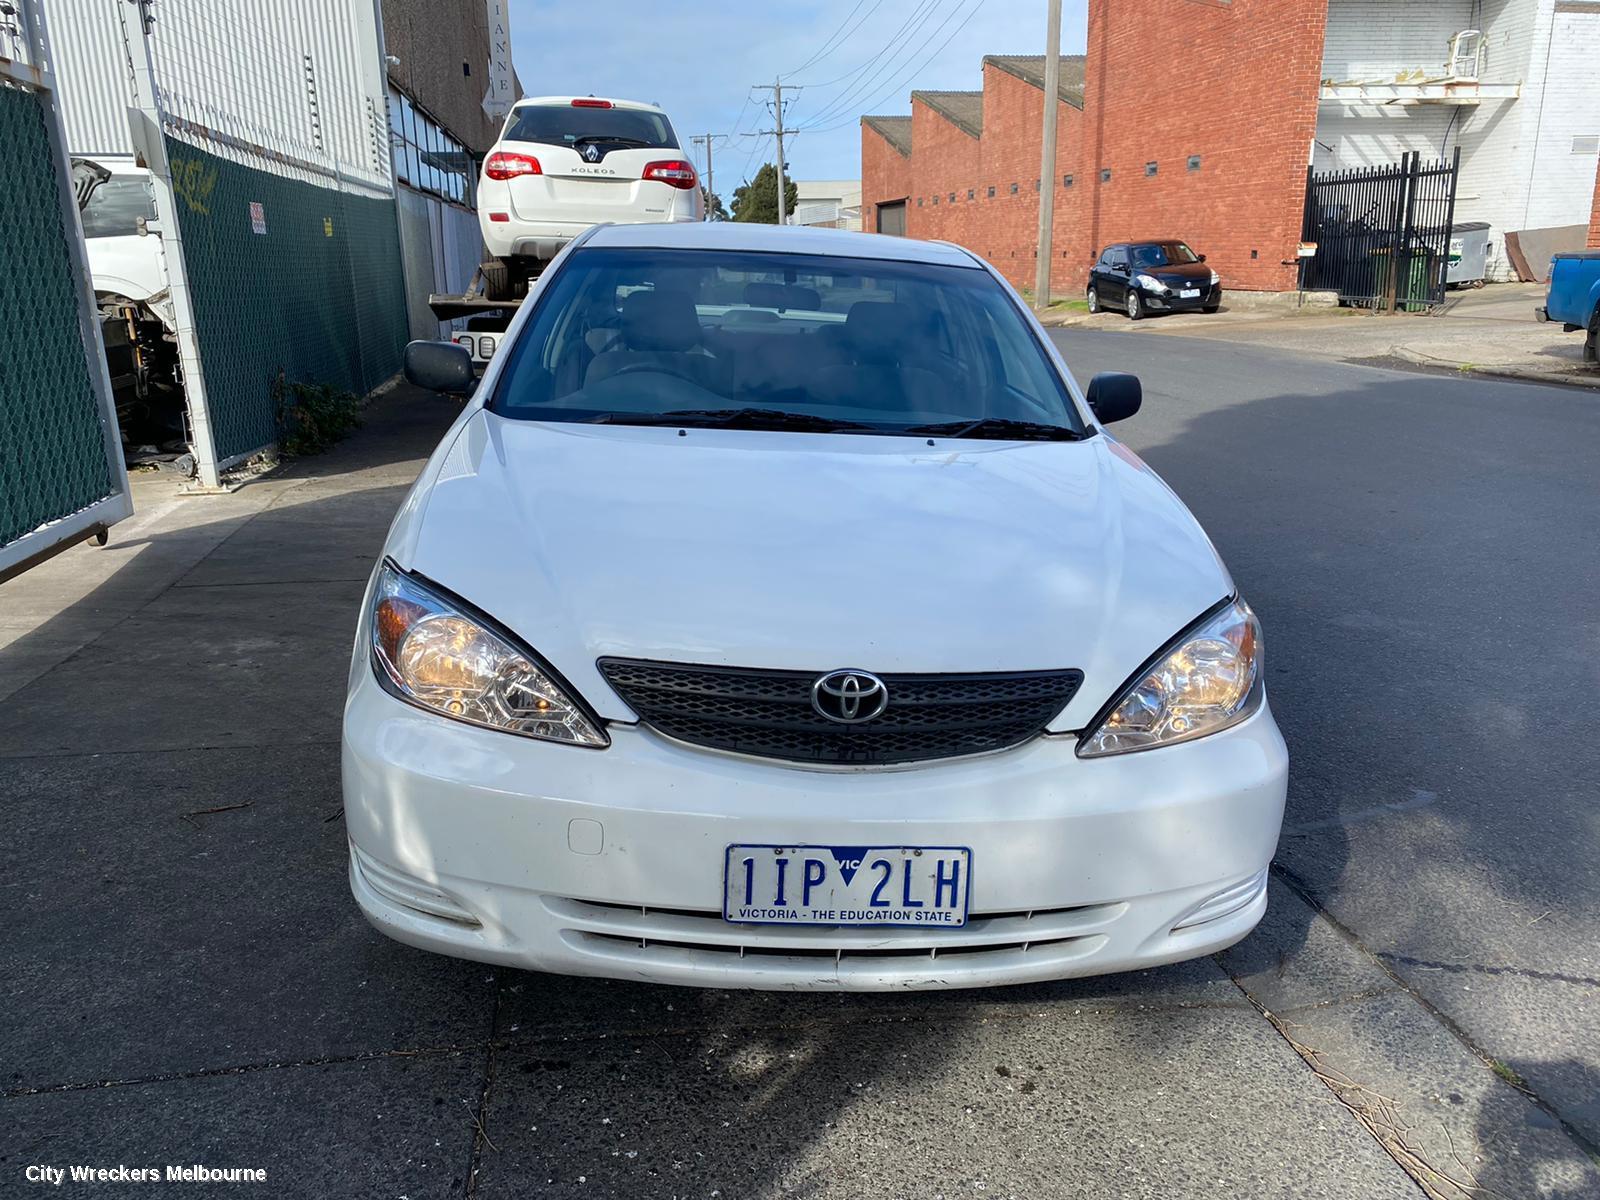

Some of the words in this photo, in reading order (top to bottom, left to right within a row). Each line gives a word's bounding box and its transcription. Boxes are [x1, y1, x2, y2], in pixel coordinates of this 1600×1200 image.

[494, 4, 509, 91] IANNE
[571, 167, 616, 175] KOLEOS
[742, 857, 826, 907] 1IP
[836, 859, 860, 870] VIC
[869, 858, 961, 908] 2LH
[739, 909, 798, 920] VICTORIA
[812, 910, 835, 920] THE
[840, 910, 911, 921] EDUCATION
[914, 911, 952, 922] STATE
